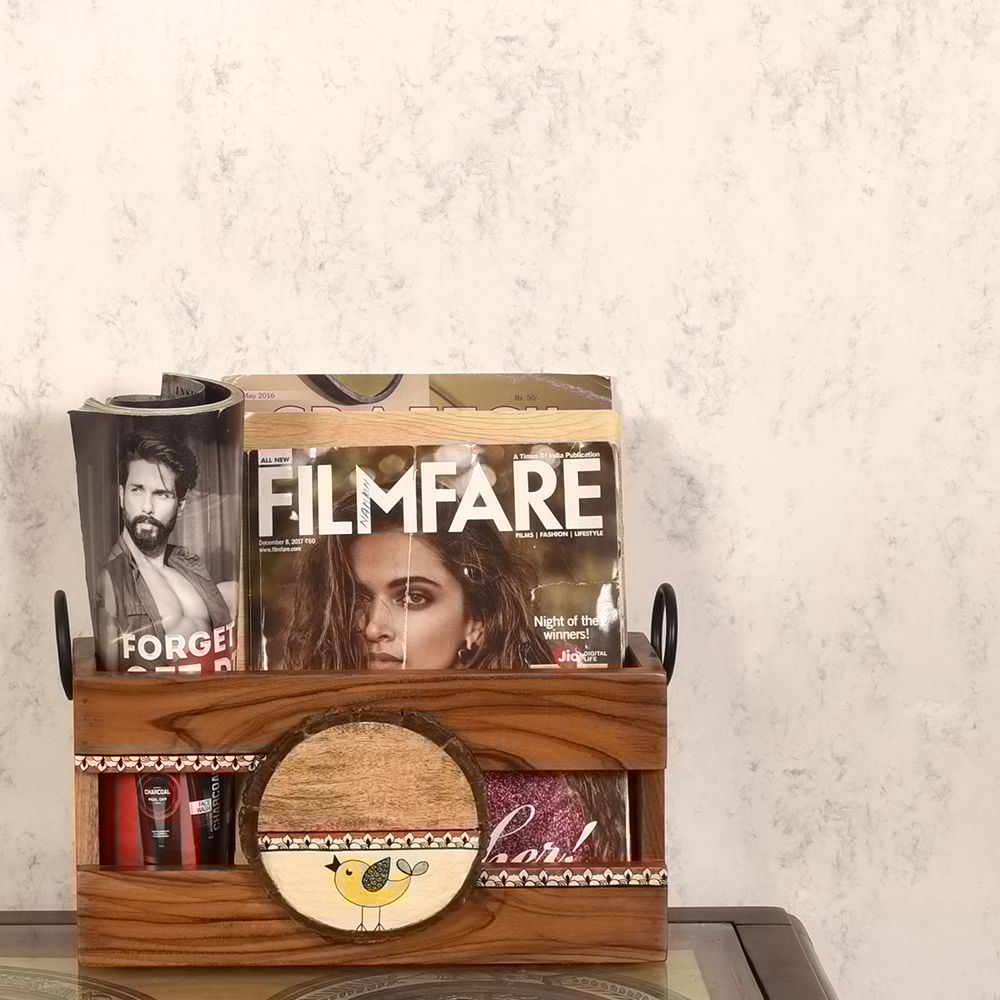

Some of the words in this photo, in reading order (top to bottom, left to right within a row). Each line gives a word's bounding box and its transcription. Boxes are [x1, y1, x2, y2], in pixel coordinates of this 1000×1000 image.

[519, 452, 539, 460] Times
[547, 451, 564, 459] India
[565, 450, 600, 458] Publication
[258, 458, 604, 537] FILMFARE
[515, 531, 534, 539] FILMS
[533, 615, 565, 629] Night
[567, 615, 578, 626] of
[581, 615, 599, 626] the
[543, 628, 590, 640] winners!
[122, 621, 235, 661] FORGET
[557, 649, 580, 662] Jio
